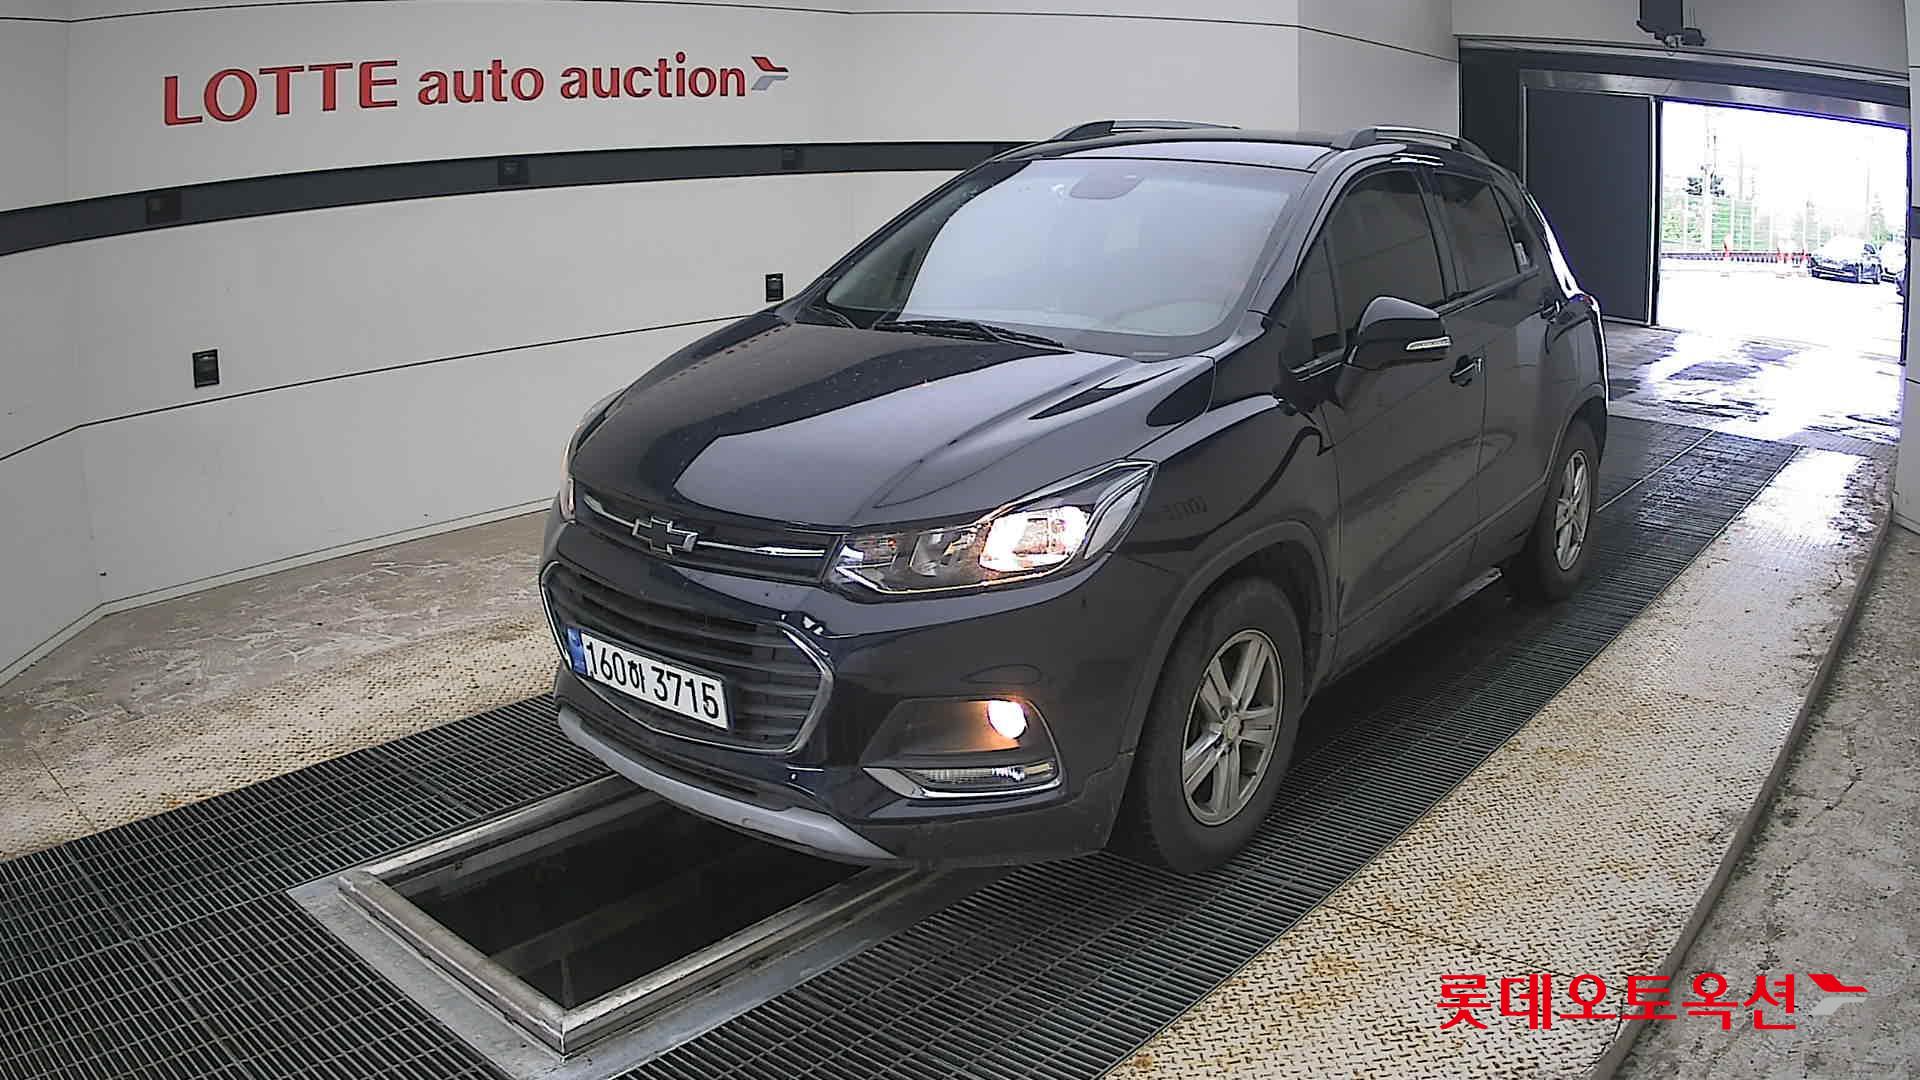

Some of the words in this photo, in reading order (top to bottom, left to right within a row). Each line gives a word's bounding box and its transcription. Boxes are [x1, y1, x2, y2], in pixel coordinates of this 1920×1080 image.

[163, 59, 399, 126] LOTTE
[417, 58, 545, 105] auto
[560, 51, 747, 97] auction
[586, 641, 646, 694] 160하
[651, 665, 720, 719] 3715
